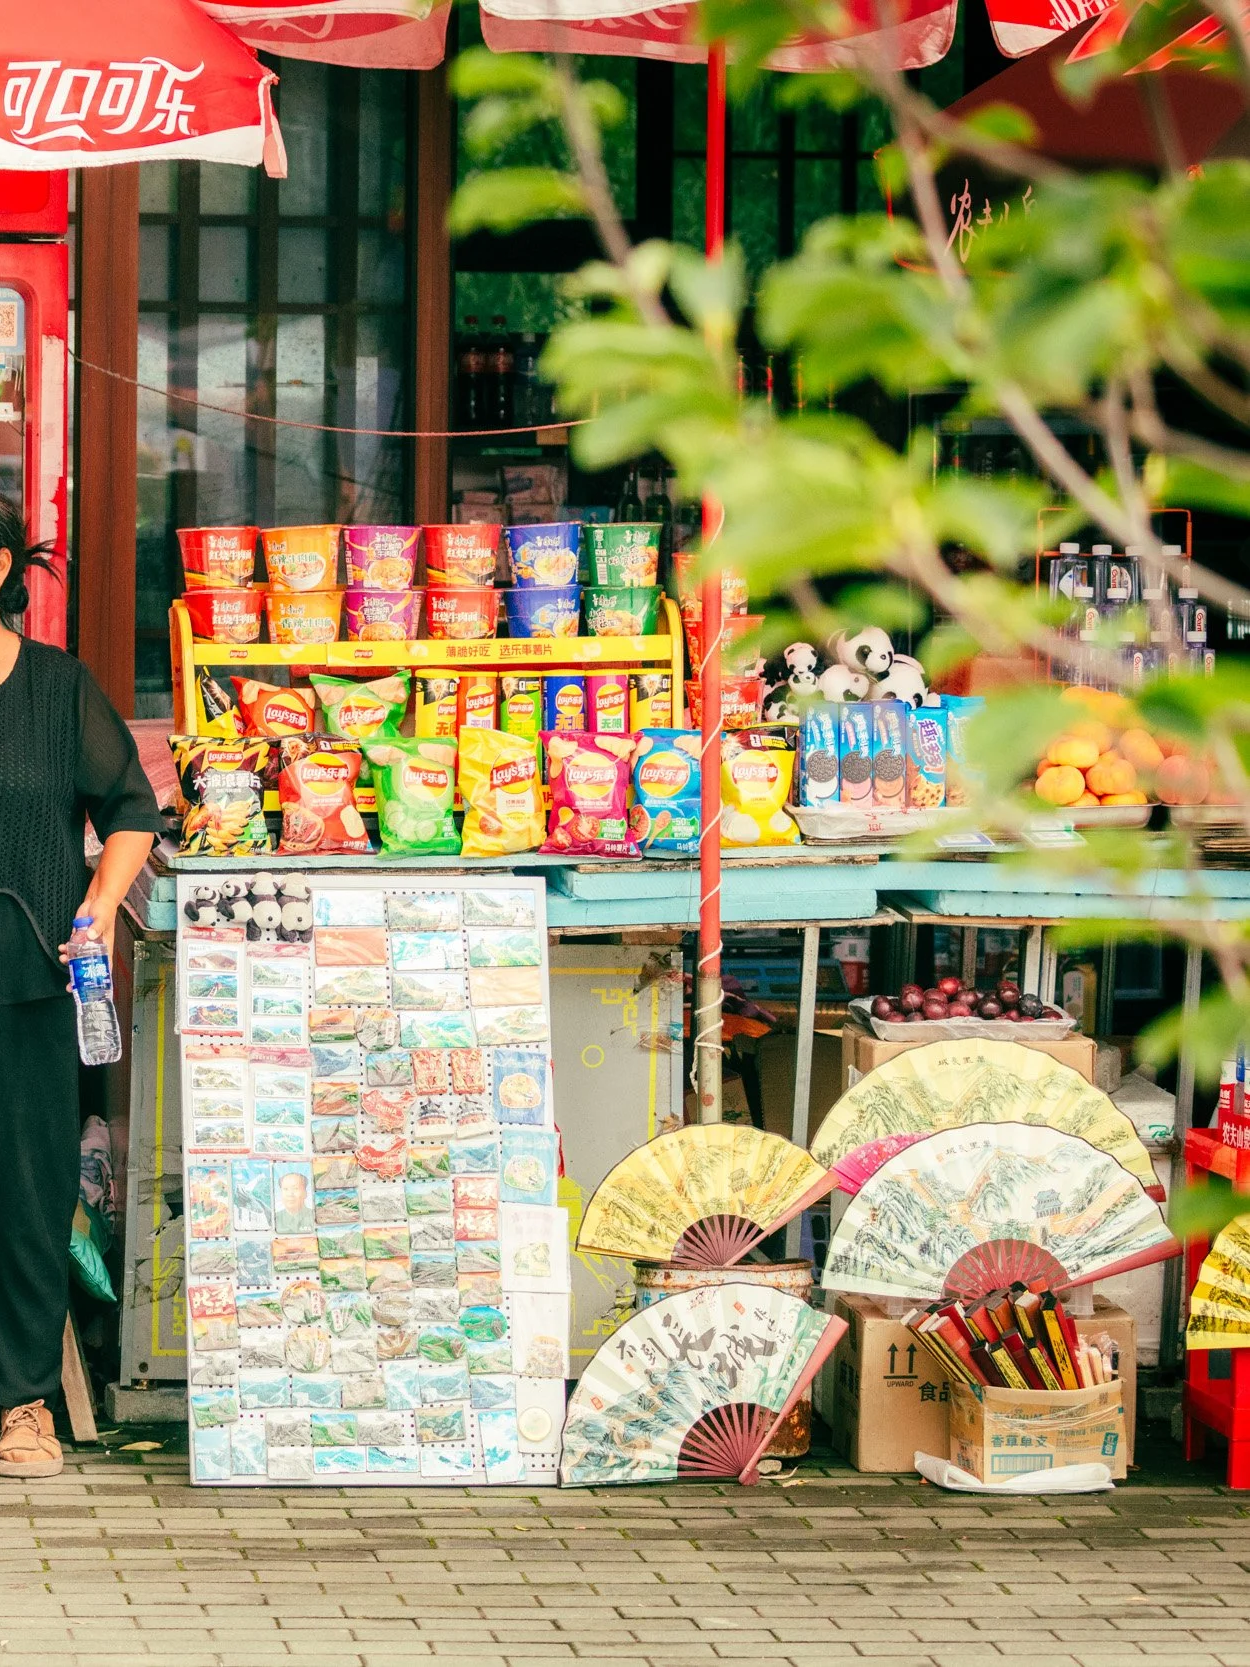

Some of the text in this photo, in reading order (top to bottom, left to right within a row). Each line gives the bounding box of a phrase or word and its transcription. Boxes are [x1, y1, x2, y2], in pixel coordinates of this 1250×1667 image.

[3, 56, 205, 143] 可口可乐
[446, 644, 552, 658] 薄脆好吃 选乐事薯片
[1222, 1121, 1250, 1150] 农夫山泉
[886, 1380, 915, 1388] UPWARD
